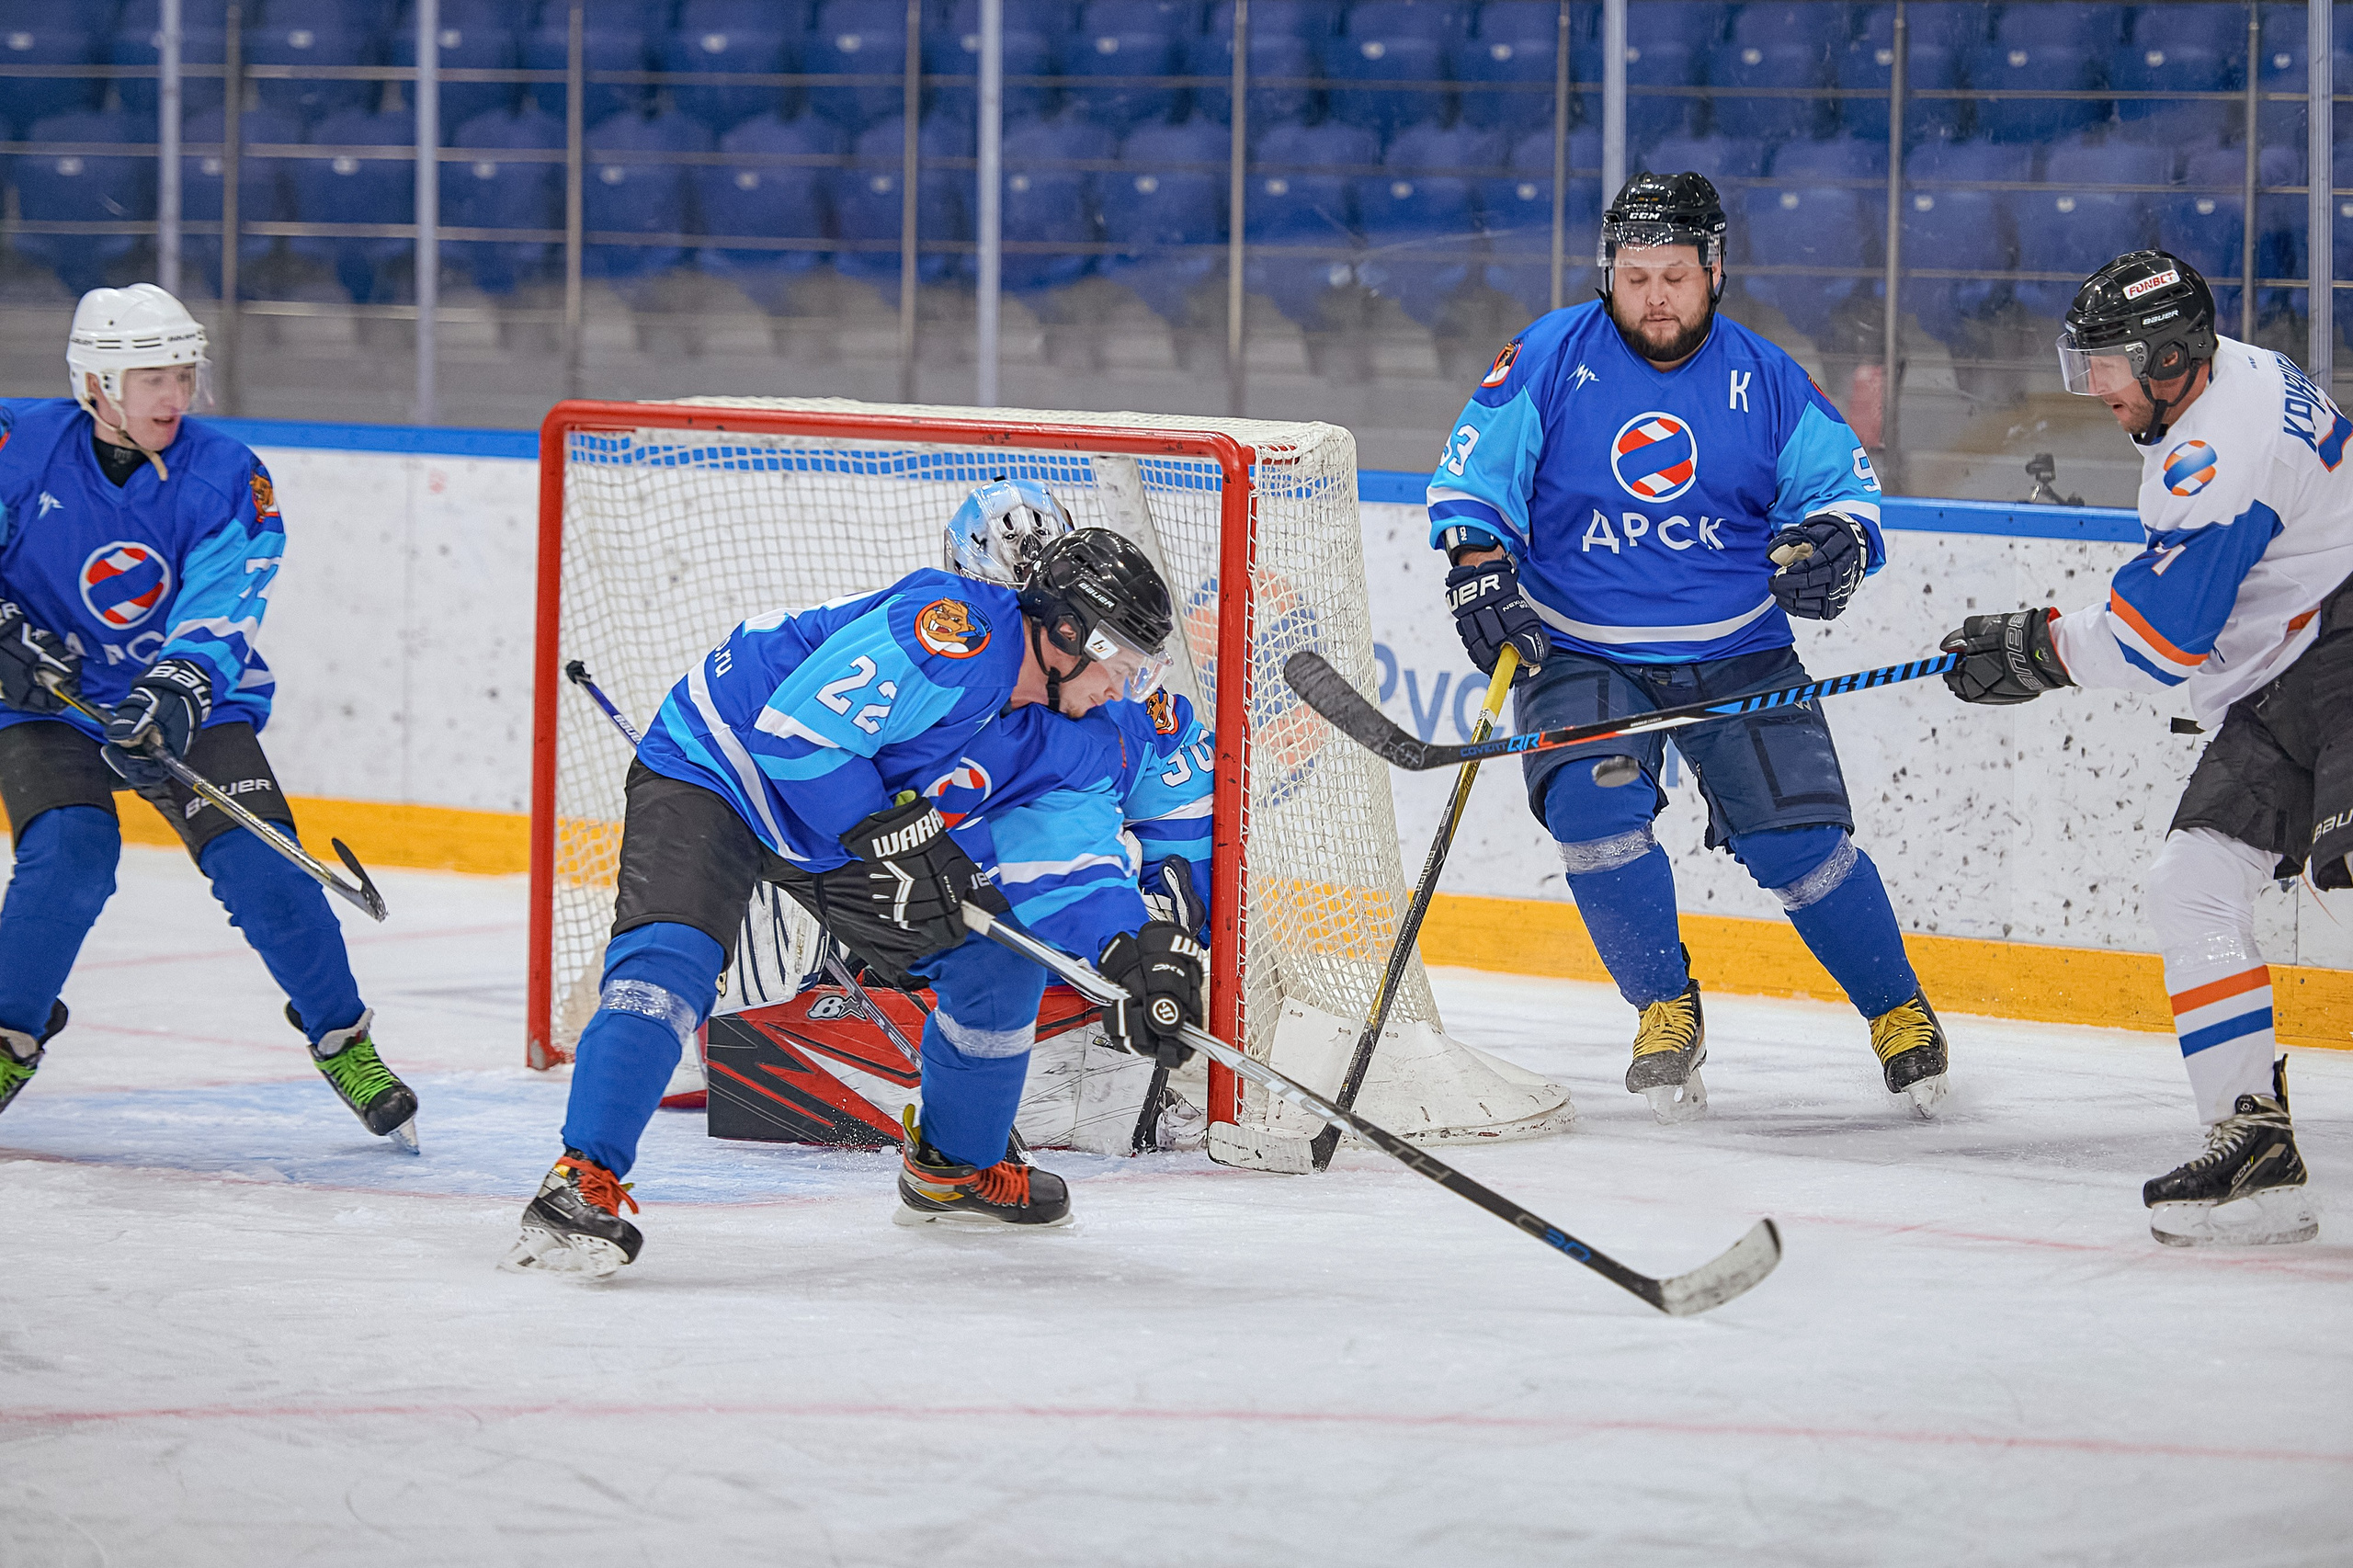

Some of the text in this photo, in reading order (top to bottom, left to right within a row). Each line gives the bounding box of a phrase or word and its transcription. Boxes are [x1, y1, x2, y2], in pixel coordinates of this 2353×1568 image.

[1628, 210, 1662, 222] CCM
[2128, 271, 2175, 297] FONBET
[2142, 309, 2180, 325] BAUER
[1077, 581, 1116, 609] BAUER
[1446, 574, 1502, 613] UER
[2006, 611, 2045, 691] BAUE
[814, 653, 899, 736] 22
[1507, 732, 1554, 753] QRL
[185, 778, 273, 820] BUER
[871, 805, 945, 858] WARR
[2312, 808, 2353, 845] BAU
